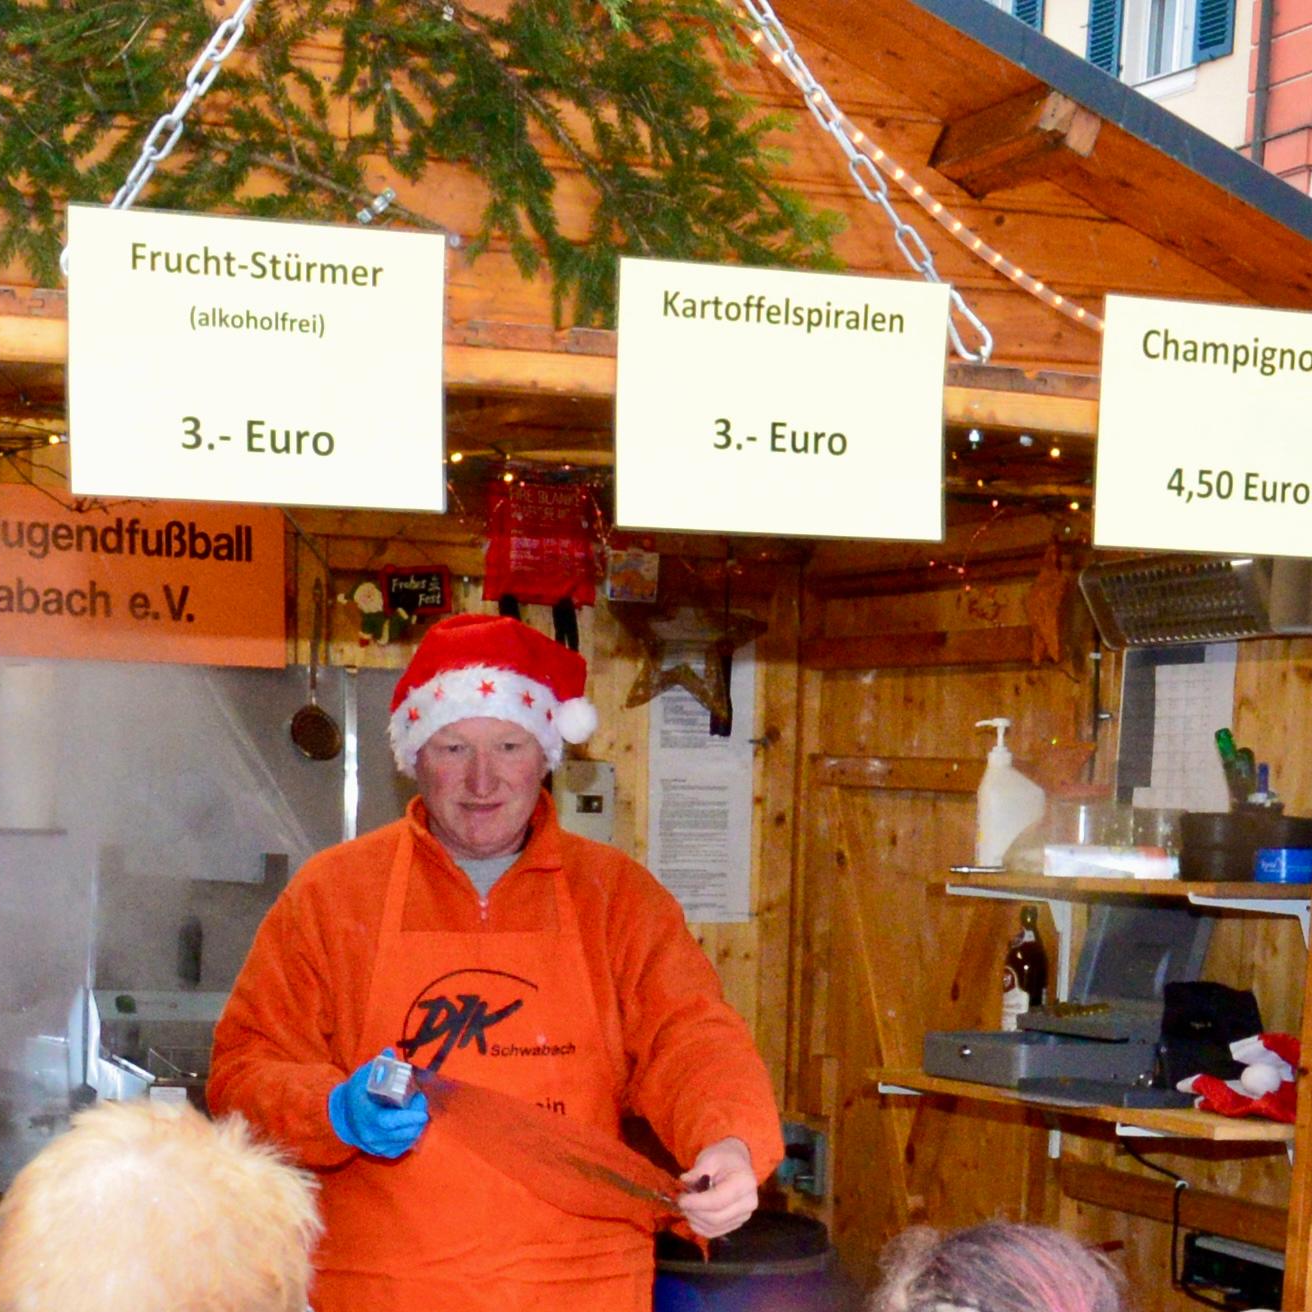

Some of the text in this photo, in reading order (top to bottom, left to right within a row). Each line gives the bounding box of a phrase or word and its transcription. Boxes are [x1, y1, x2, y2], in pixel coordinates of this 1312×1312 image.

[131, 242, 384, 288] Frucht-Stürmer
[189, 307, 326, 338] (alkoholfrei)
[662, 291, 905, 334] Kartoffelspiralen
[181, 416, 336, 458] 3.- Euro
[713, 418, 848, 457] 3.- Euro
[1166, 468, 1311, 506] 4,50 Euro
[128, 584, 196, 623] e.V.
[397, 994, 524, 1075] DJK
[490, 1041, 576, 1057] Schwabach
